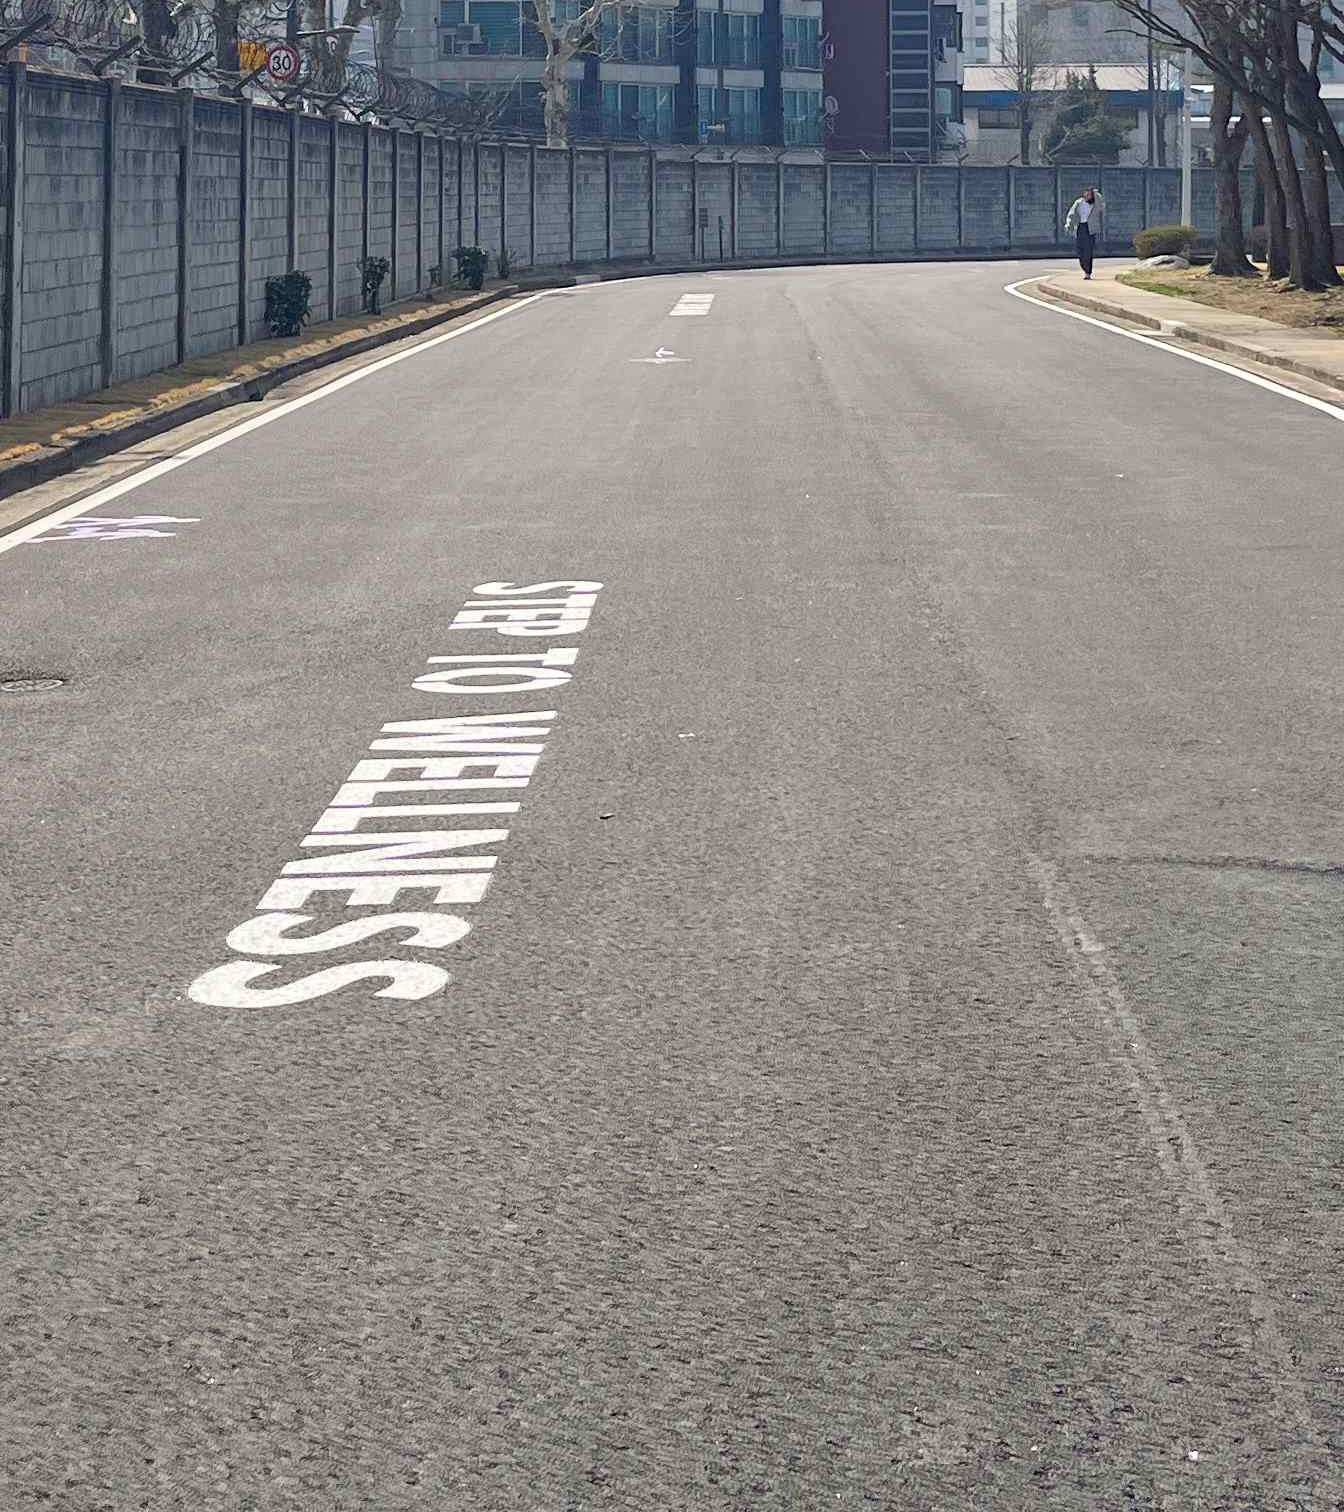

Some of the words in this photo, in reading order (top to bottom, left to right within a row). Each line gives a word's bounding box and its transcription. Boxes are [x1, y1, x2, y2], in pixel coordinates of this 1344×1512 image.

[272, 55, 292, 72] 30
[447, 580, 604, 637] STEP
[411, 647, 580, 694] TO
[187, 710, 558, 1009] WELLNESS
